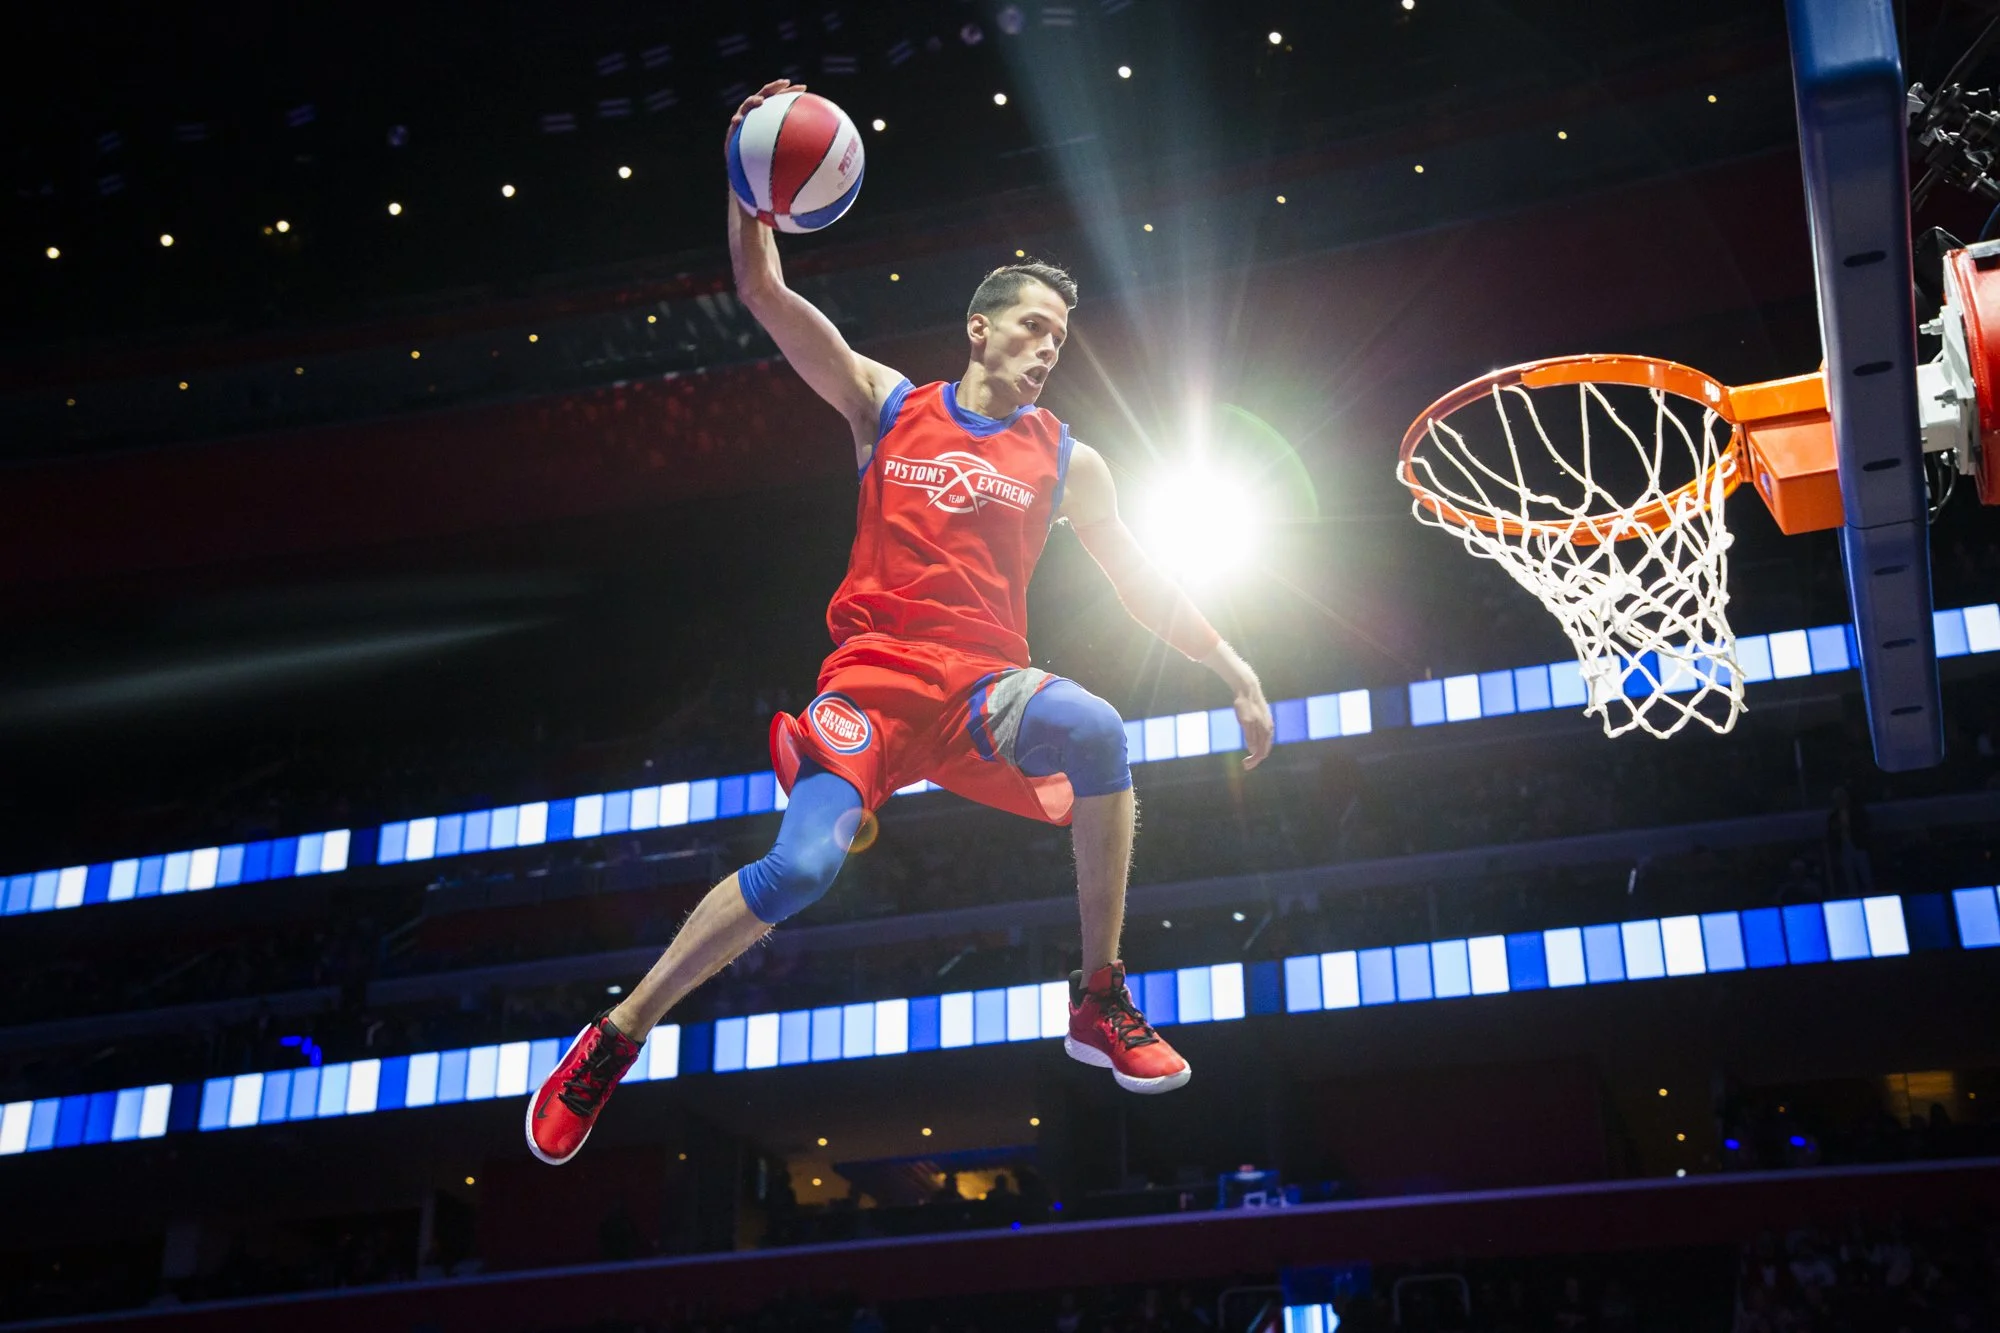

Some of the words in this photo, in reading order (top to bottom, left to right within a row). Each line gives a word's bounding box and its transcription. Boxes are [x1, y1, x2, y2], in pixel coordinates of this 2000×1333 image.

[884, 460, 947, 484] PISTONS
[948, 494, 966, 503] TEAM
[820, 715, 859, 741] PISTONS
[823, 706, 861, 734] DETROIT
